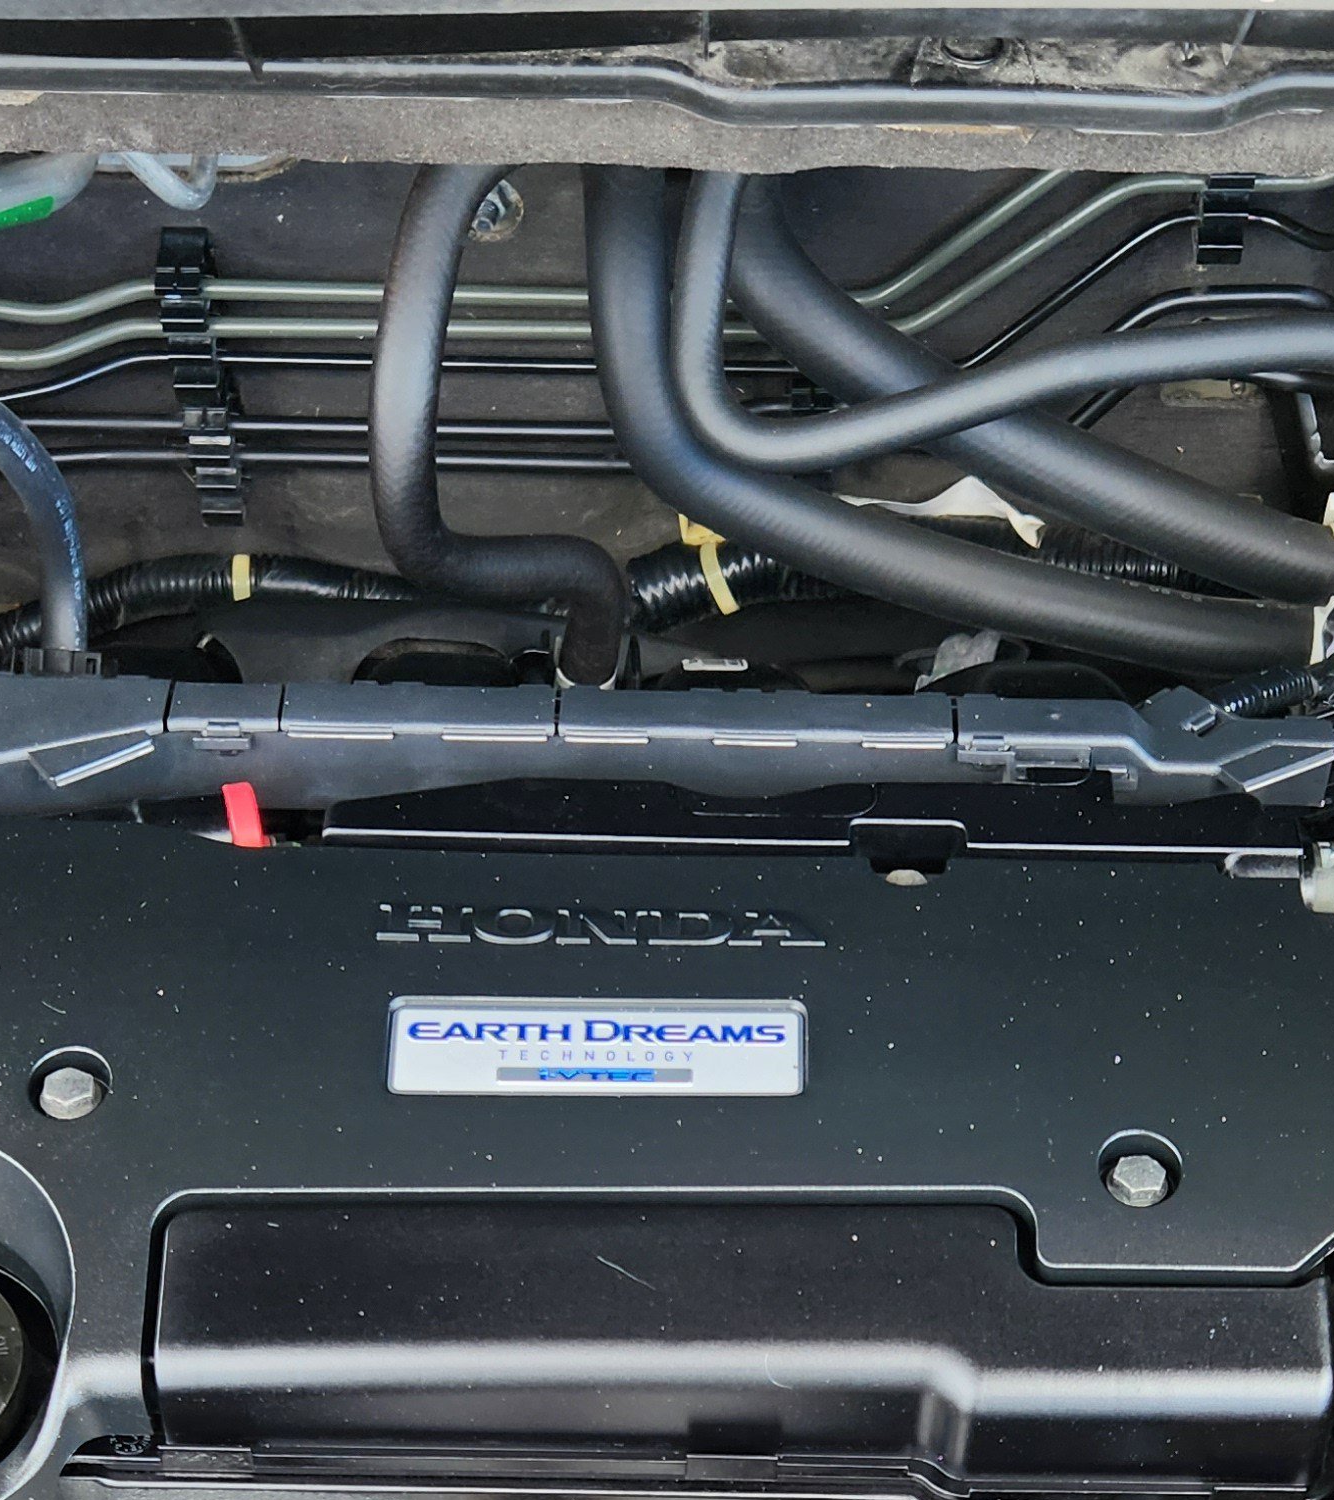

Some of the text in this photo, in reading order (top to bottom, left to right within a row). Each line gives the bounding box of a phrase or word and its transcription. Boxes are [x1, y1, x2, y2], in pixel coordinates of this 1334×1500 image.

[375, 903, 827, 947] HONDA
[406, 1019, 787, 1043] EARTH DREAMS
[498, 1049, 695, 1063] TECHNOLOGY
